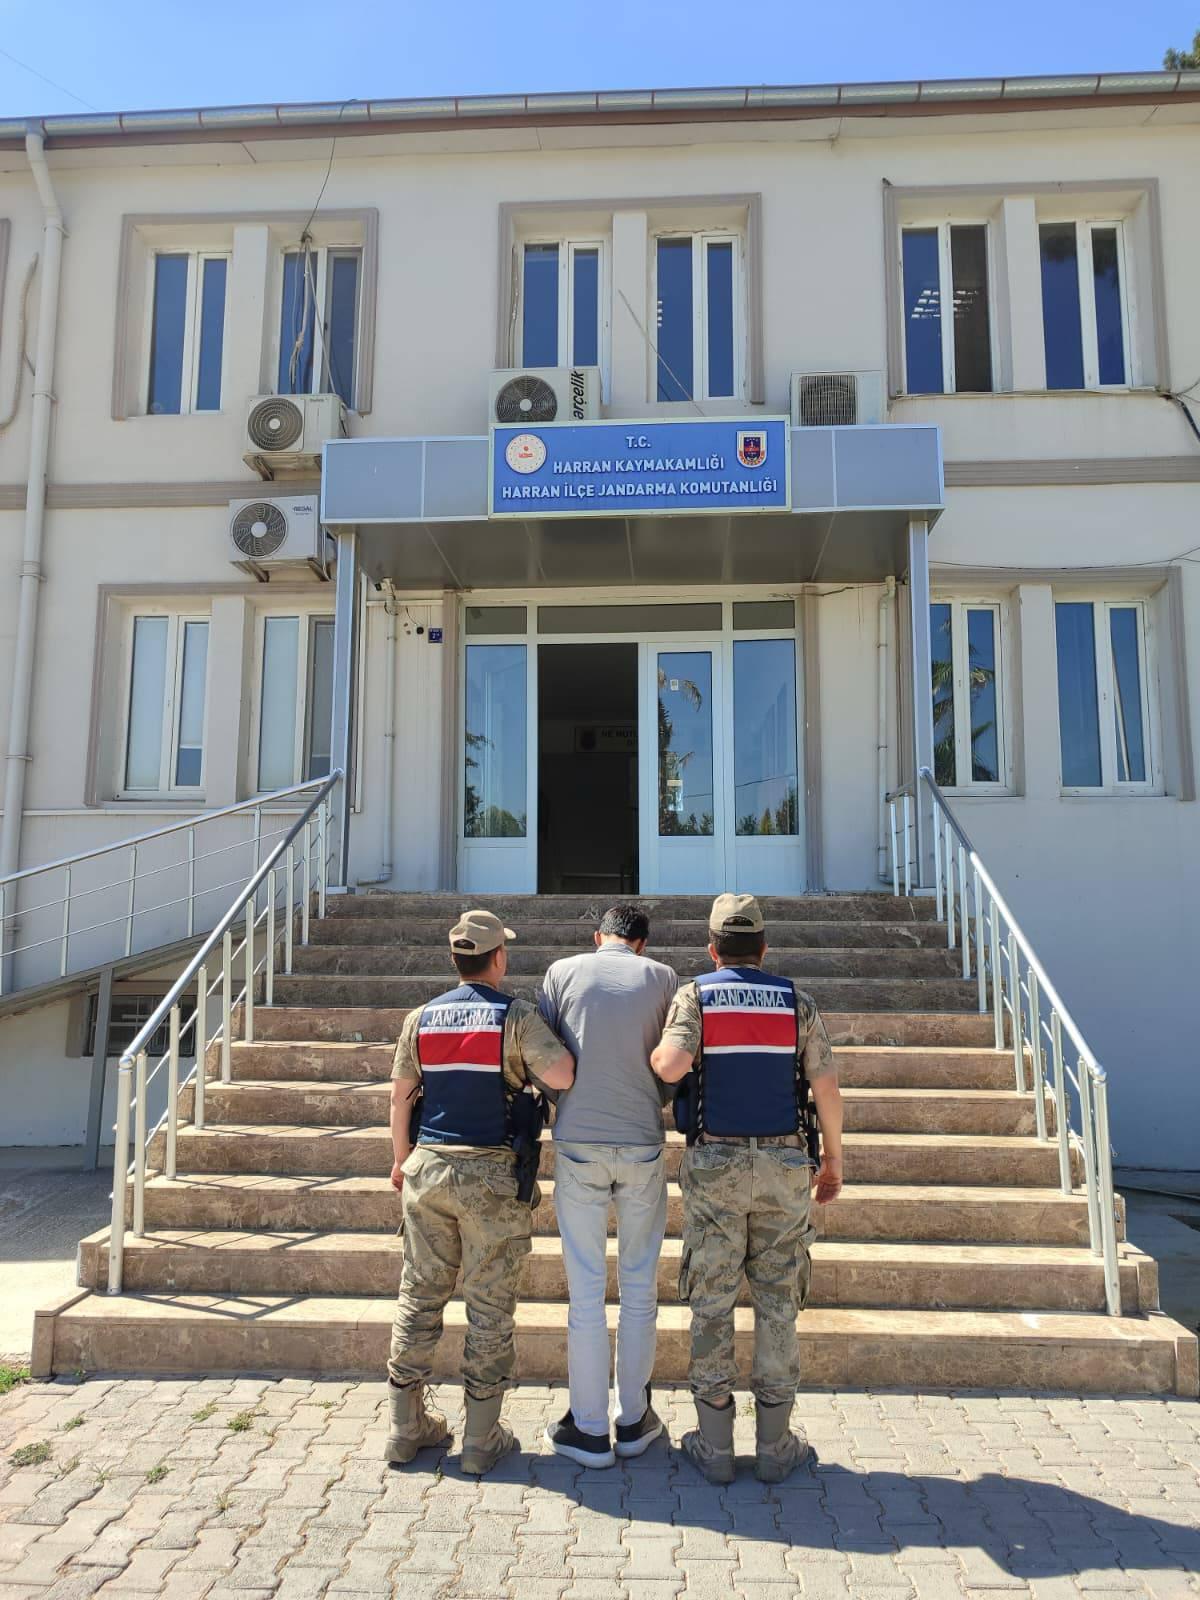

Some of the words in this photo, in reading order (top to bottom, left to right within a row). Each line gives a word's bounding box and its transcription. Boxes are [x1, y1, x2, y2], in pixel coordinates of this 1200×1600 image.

[570, 370, 588, 420] arçelik
[626, 436, 652, 449] T.C.
[553, 460, 611, 474] HARRAN
[615, 453, 725, 472] KAYMAKAMLIĞI
[502, 485, 560, 499] HARRAN
[564, 482, 595, 499] İLÇE
[598, 482, 676, 497] JANDARMA
[680, 476, 777, 495] KOMUTANLIĞI
[710, 989, 787, 1007] JANDARMA
[427, 1008, 497, 1026] JANDARMA
